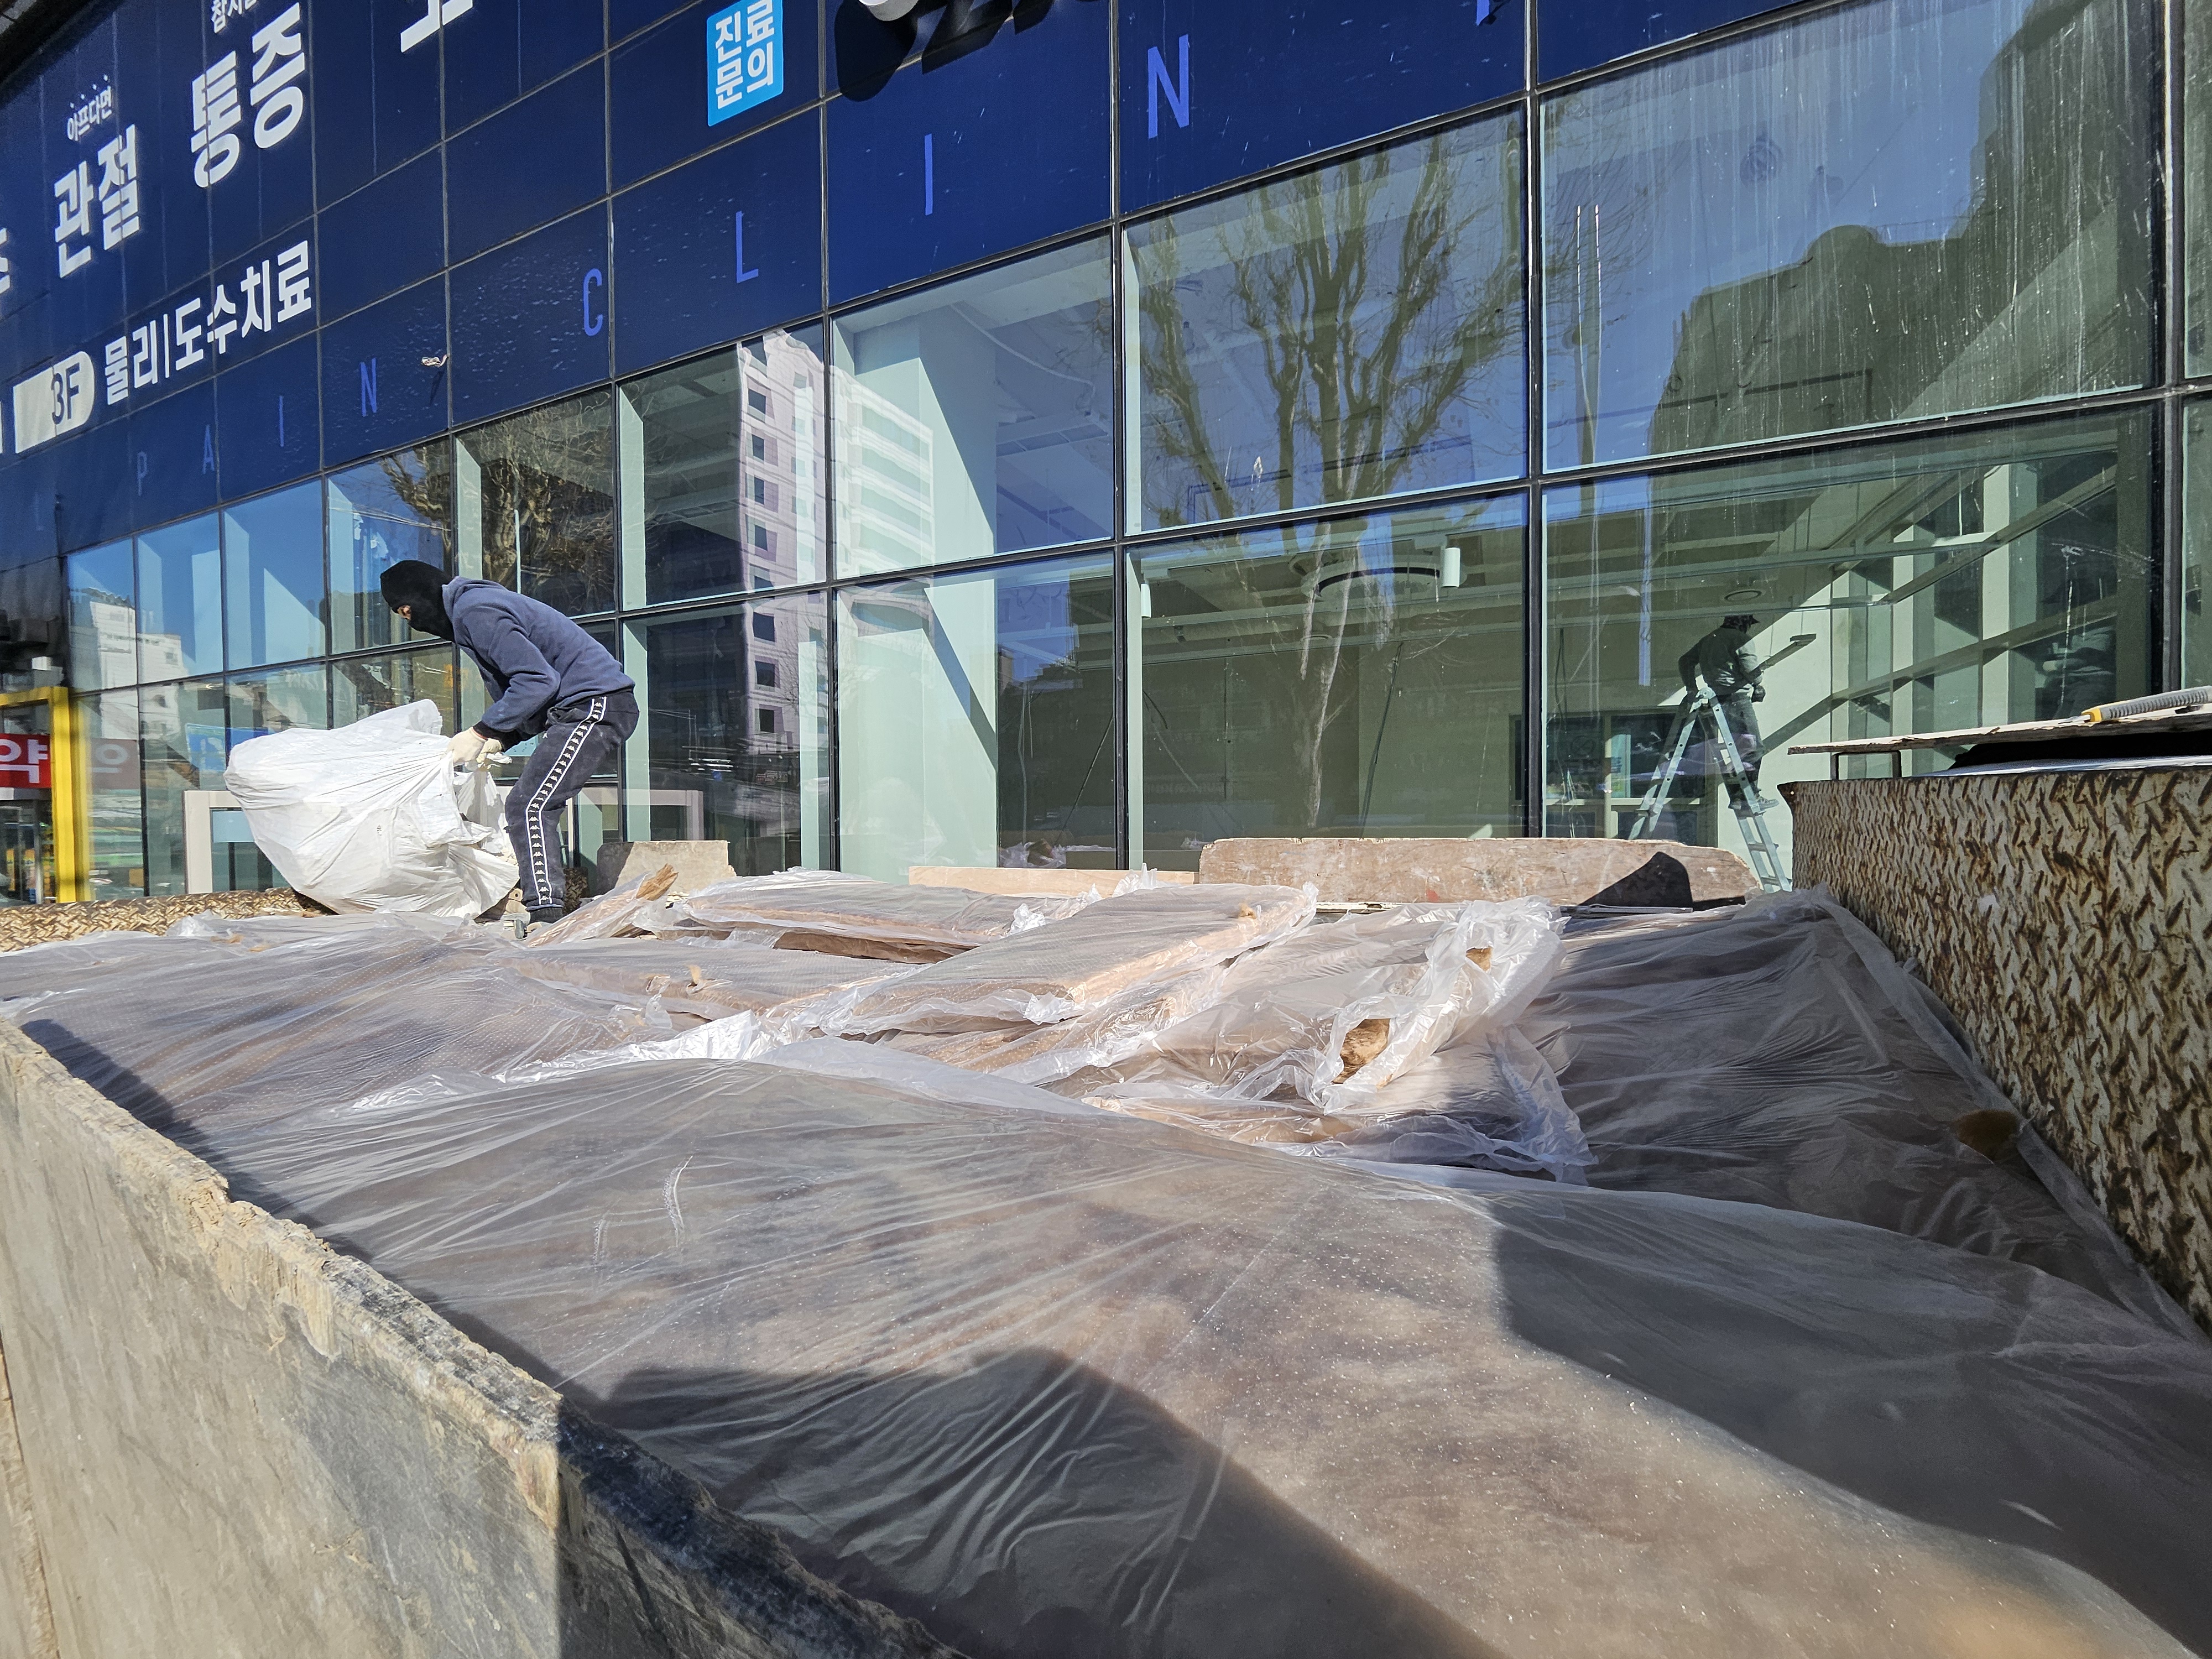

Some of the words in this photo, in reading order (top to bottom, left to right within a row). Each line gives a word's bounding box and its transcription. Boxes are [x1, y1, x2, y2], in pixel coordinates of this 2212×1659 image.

[716, 0, 774, 64] 진료
[716, 41, 773, 109] 문의
[54, 124, 139, 278] 관절
[191, 2, 305, 187] 통증
[67, 85, 112, 140] 아프다면
[51, 362, 80, 425] 3F
